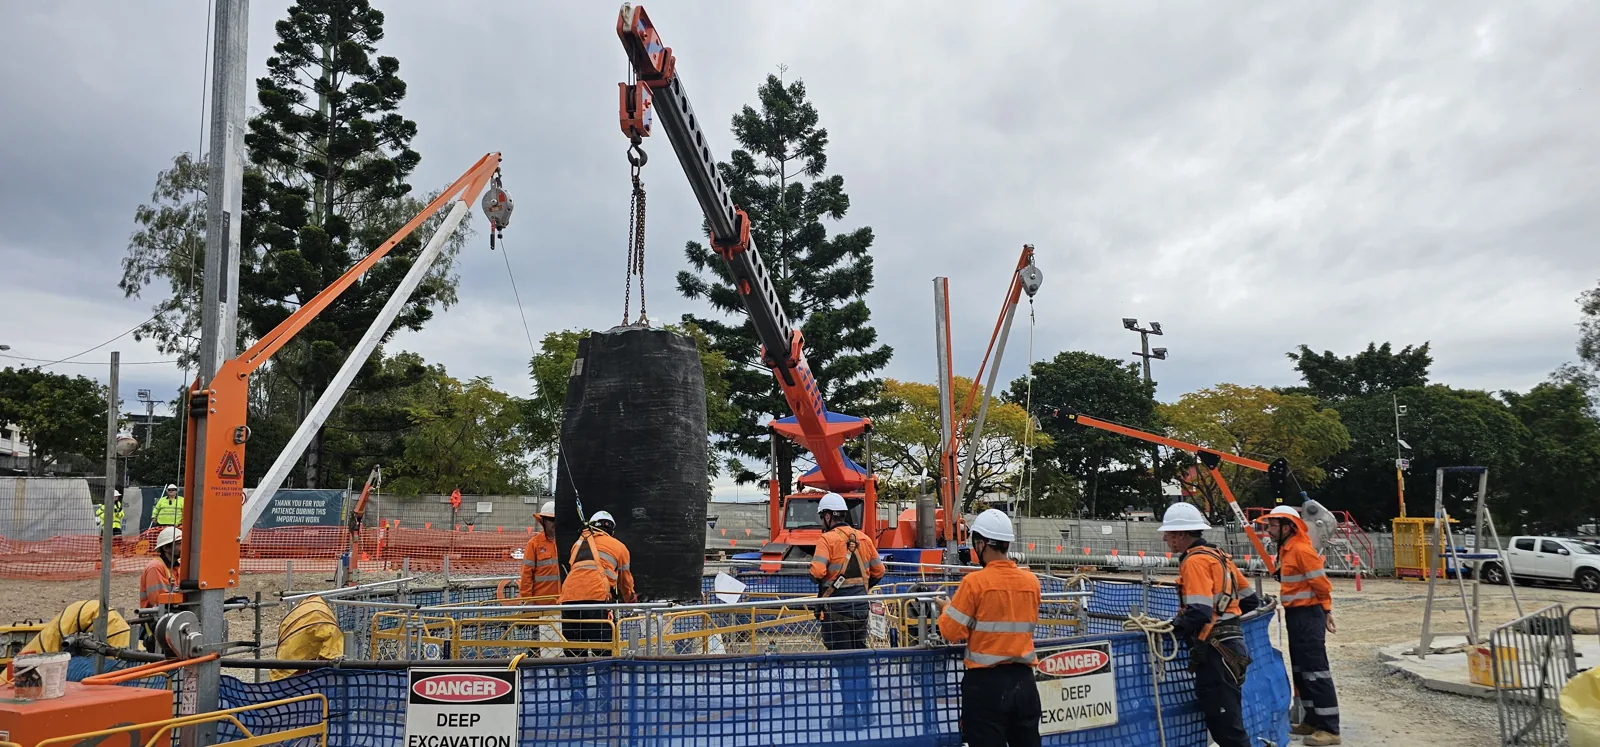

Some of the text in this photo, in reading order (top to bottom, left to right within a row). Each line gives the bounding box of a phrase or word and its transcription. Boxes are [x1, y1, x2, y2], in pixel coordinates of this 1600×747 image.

[271, 507, 295, 515] PATIENCE
[276, 515, 305, 523] IMPORTANT
[1045, 653, 1100, 673] DANGER
[425, 681, 496, 696] DANGER
[1061, 684, 1091, 701] DEEP
[1040, 701, 1112, 724] EXCAVATION
[437, 713, 481, 727] DEEP
[408, 735, 511, 747] EXCAVATION
